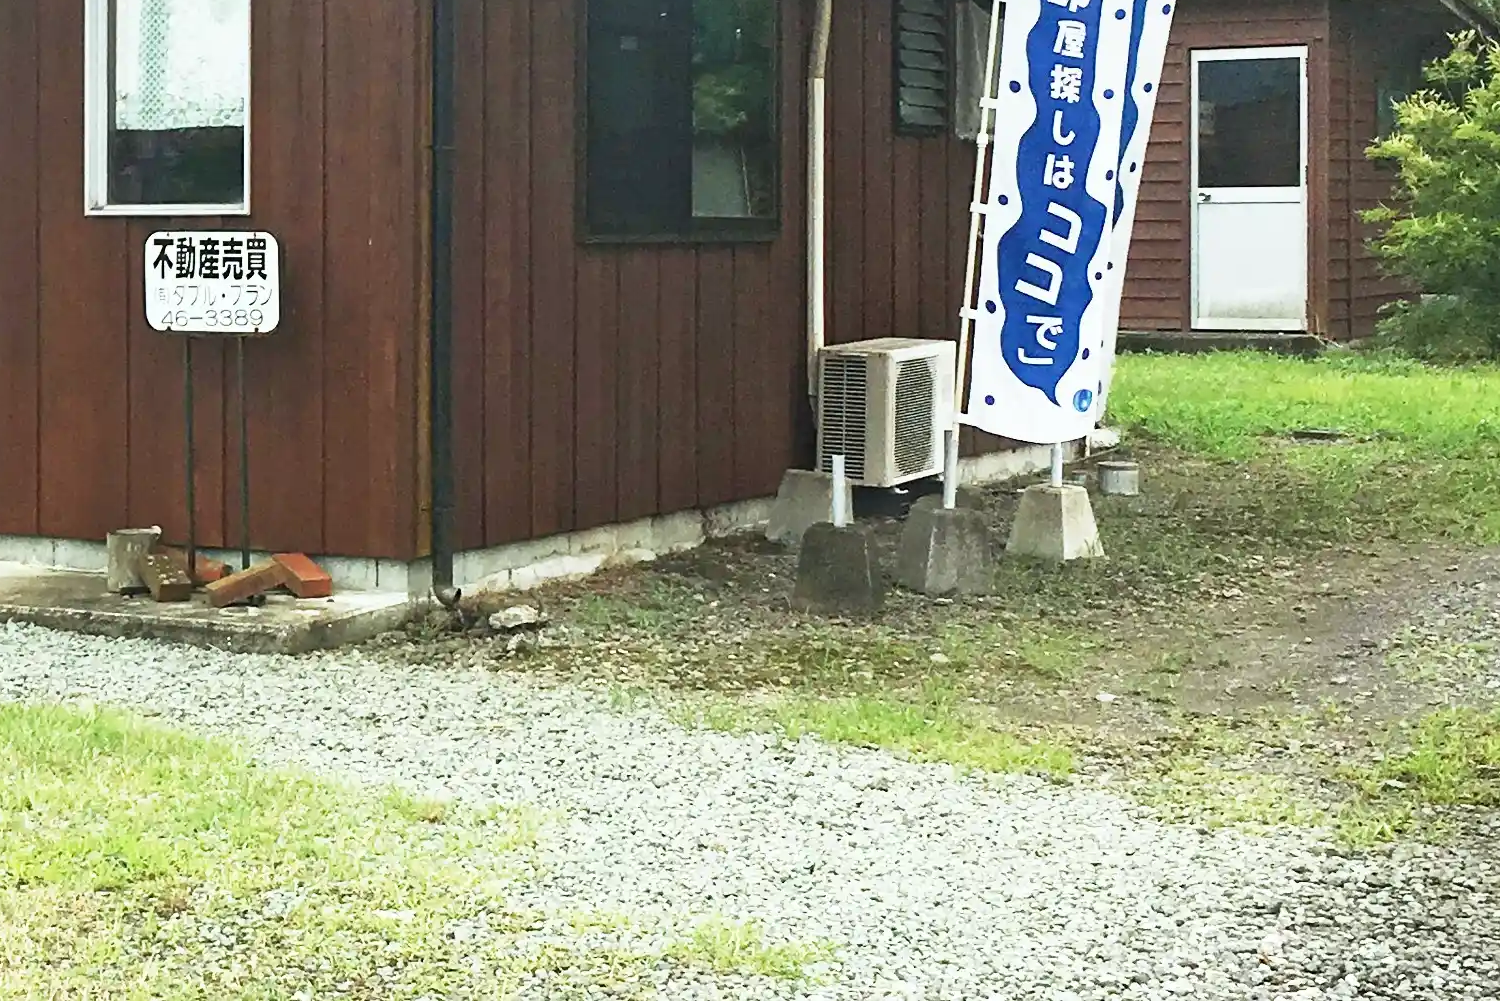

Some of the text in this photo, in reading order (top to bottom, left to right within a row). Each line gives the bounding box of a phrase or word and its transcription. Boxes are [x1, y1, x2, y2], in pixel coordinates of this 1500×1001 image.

[153, 237, 267, 280] 不動産売買
[161, 309, 263, 326] 46-3389
